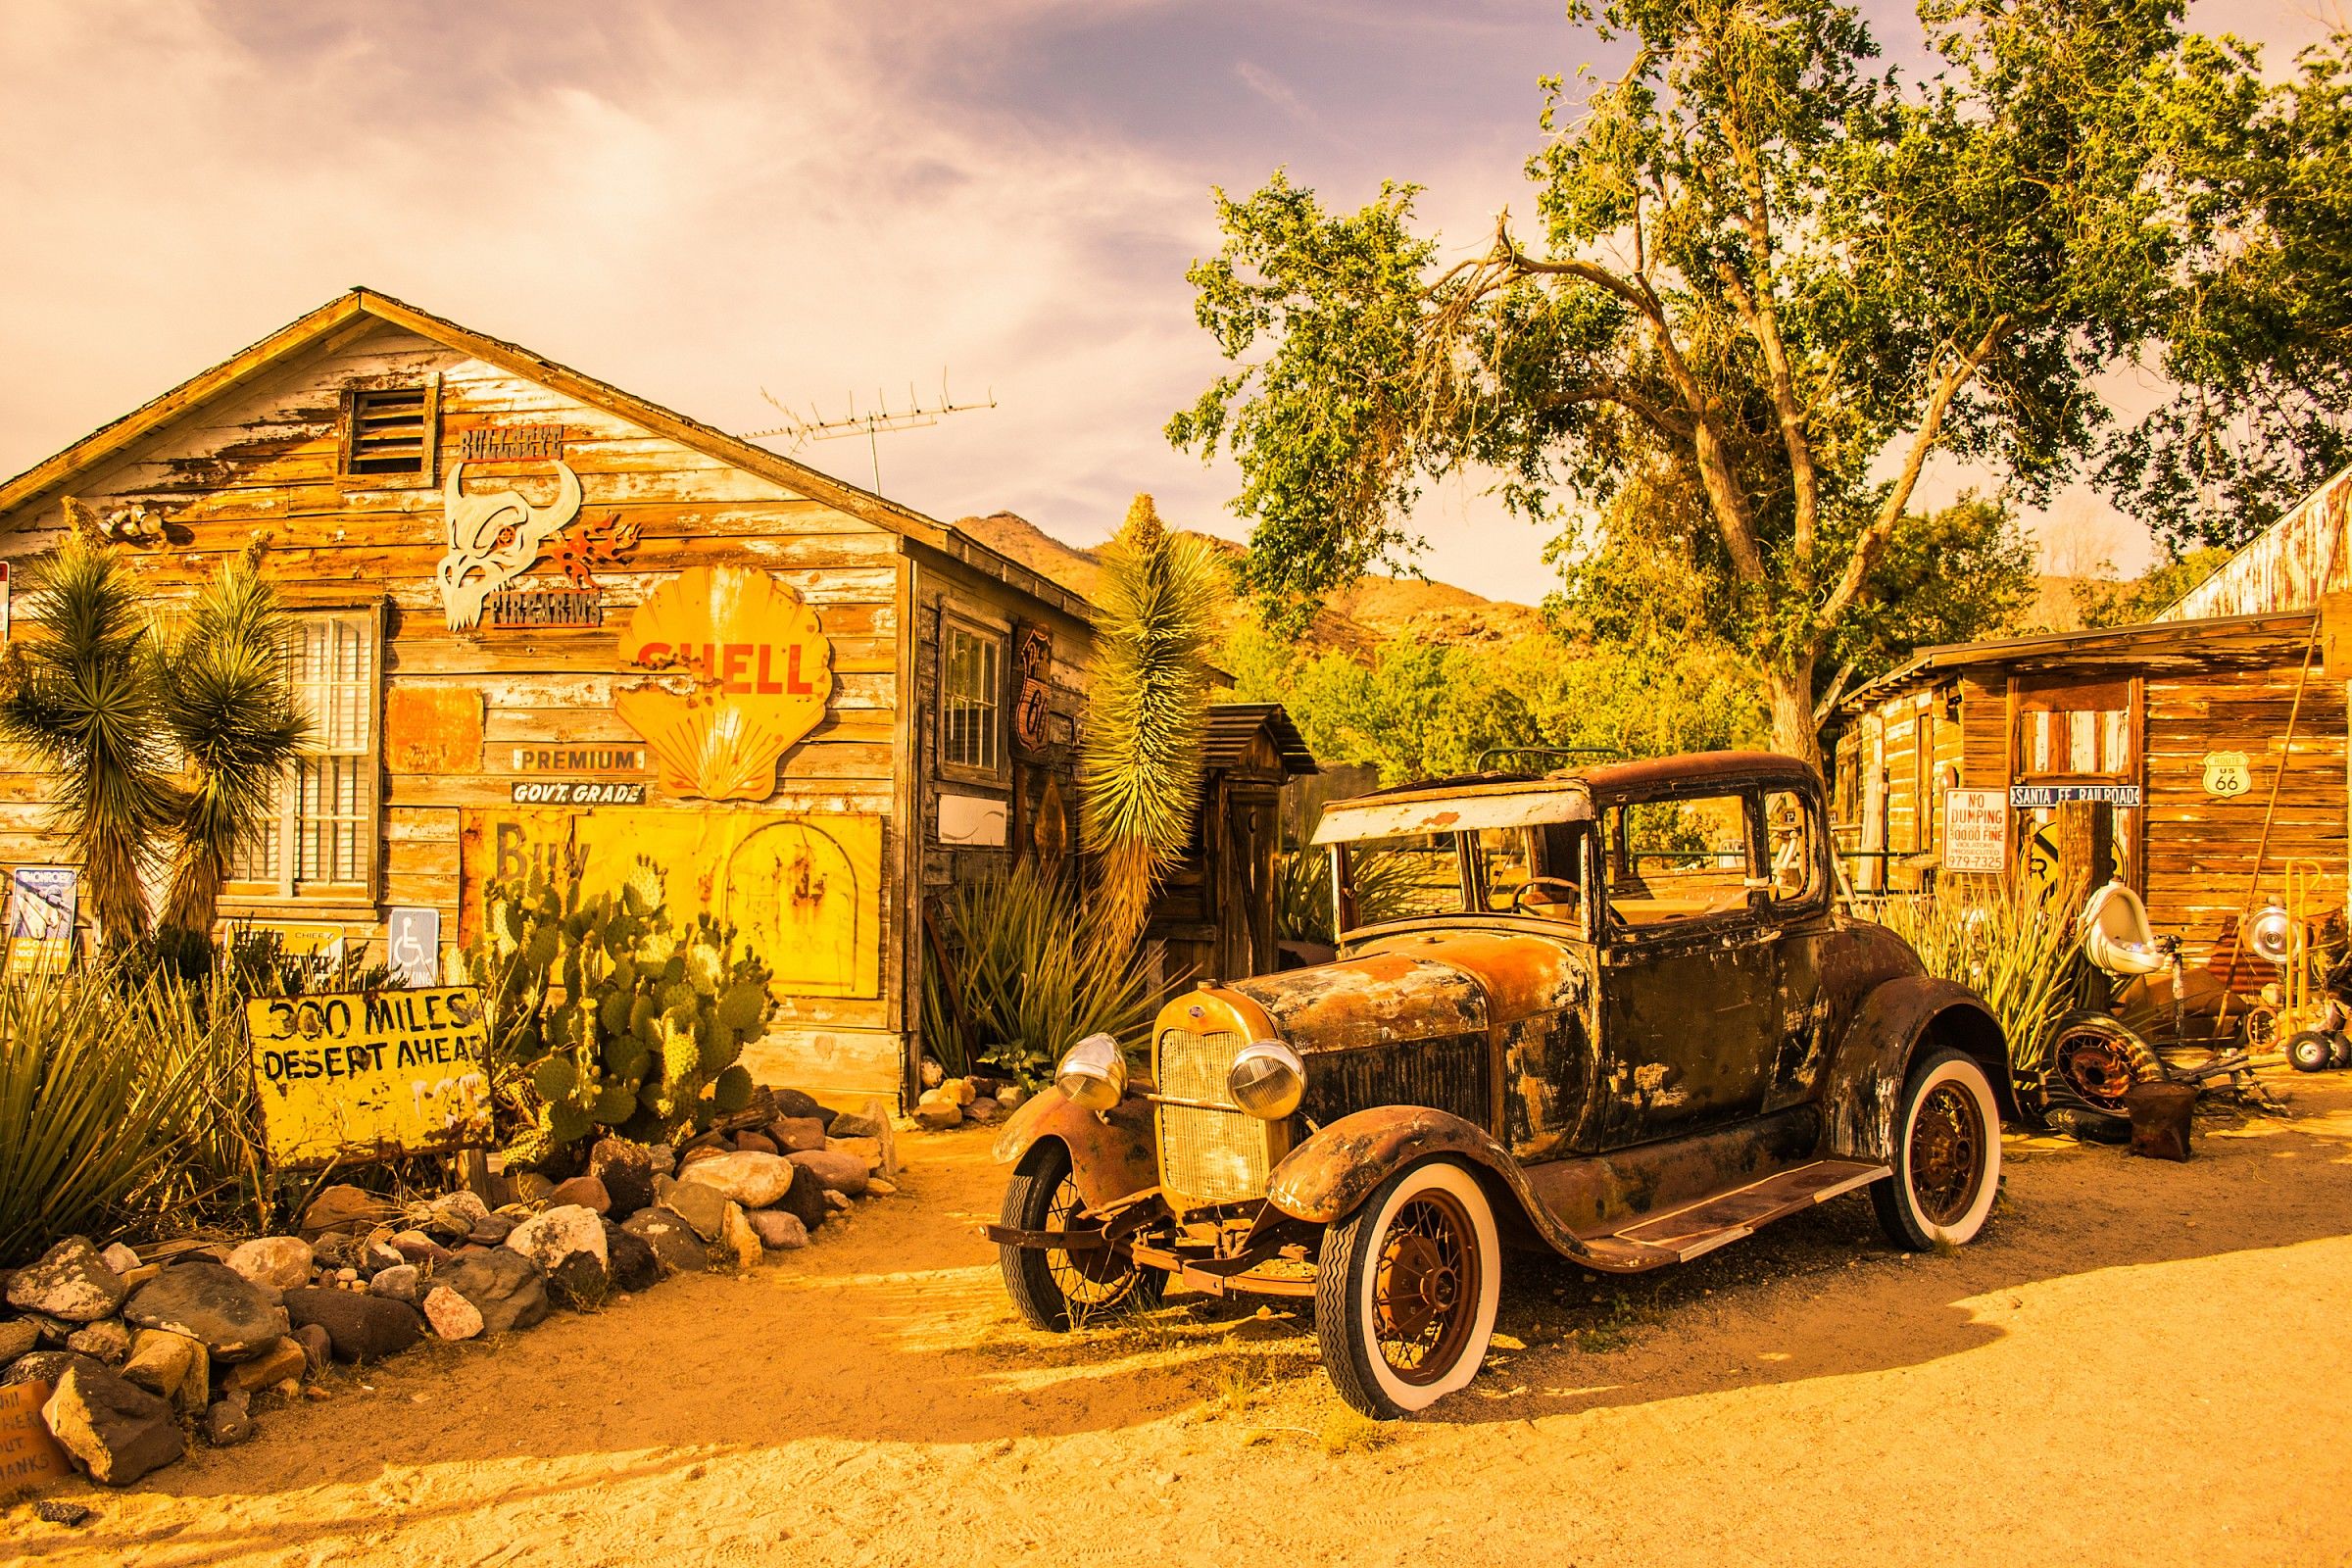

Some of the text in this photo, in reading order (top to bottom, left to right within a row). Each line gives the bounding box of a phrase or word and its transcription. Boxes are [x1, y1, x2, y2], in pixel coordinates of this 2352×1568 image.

[462, 425, 563, 460] BULLSEYE
[490, 592, 601, 625] FIREARMS
[522, 751, 635, 769] PREMIUM
[2216, 776, 2237, 790] 66
[572, 784, 642, 802] GRADE
[1968, 794, 1984, 808] NO
[2016, 788, 2134, 804] SANTA FE RAILROAD
[1951, 809, 2002, 823] DUMPING
[1984, 830, 2003, 841] FINE
[1948, 856, 2001, 867] 979-7325
[269, 993, 474, 1042] 300 MILES
[264, 1035, 487, 1079] DESERT AHEAD
